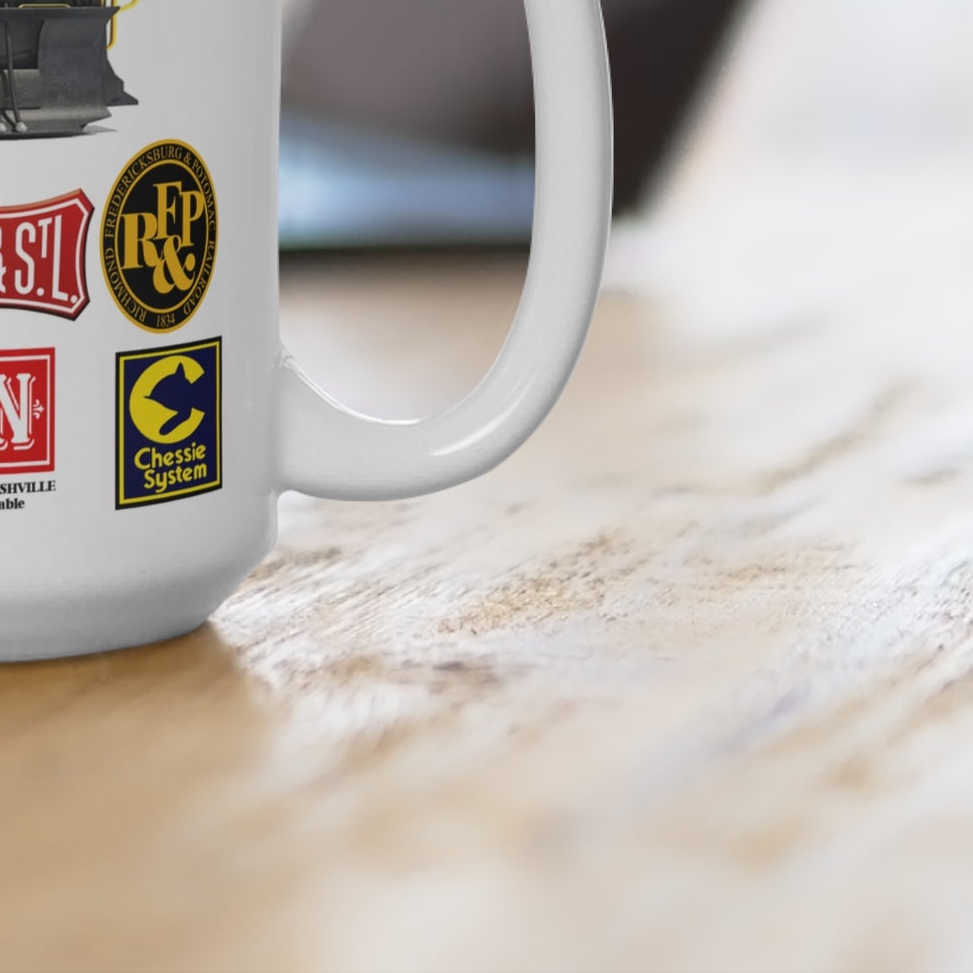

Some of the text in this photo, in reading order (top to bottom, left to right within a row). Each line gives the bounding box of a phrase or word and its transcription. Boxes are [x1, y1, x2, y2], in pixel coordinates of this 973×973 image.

[105, 146, 183, 237] FREDERICKSBURG
[191, 160, 216, 226] POTOMAC
[105, 247, 147, 323] RICHMOND
[183, 240, 215, 316] RAILROAD
[156, 313, 175, 327] 1834
[134, 441, 206, 470] Chessie
[143, 463, 207, 493] System
